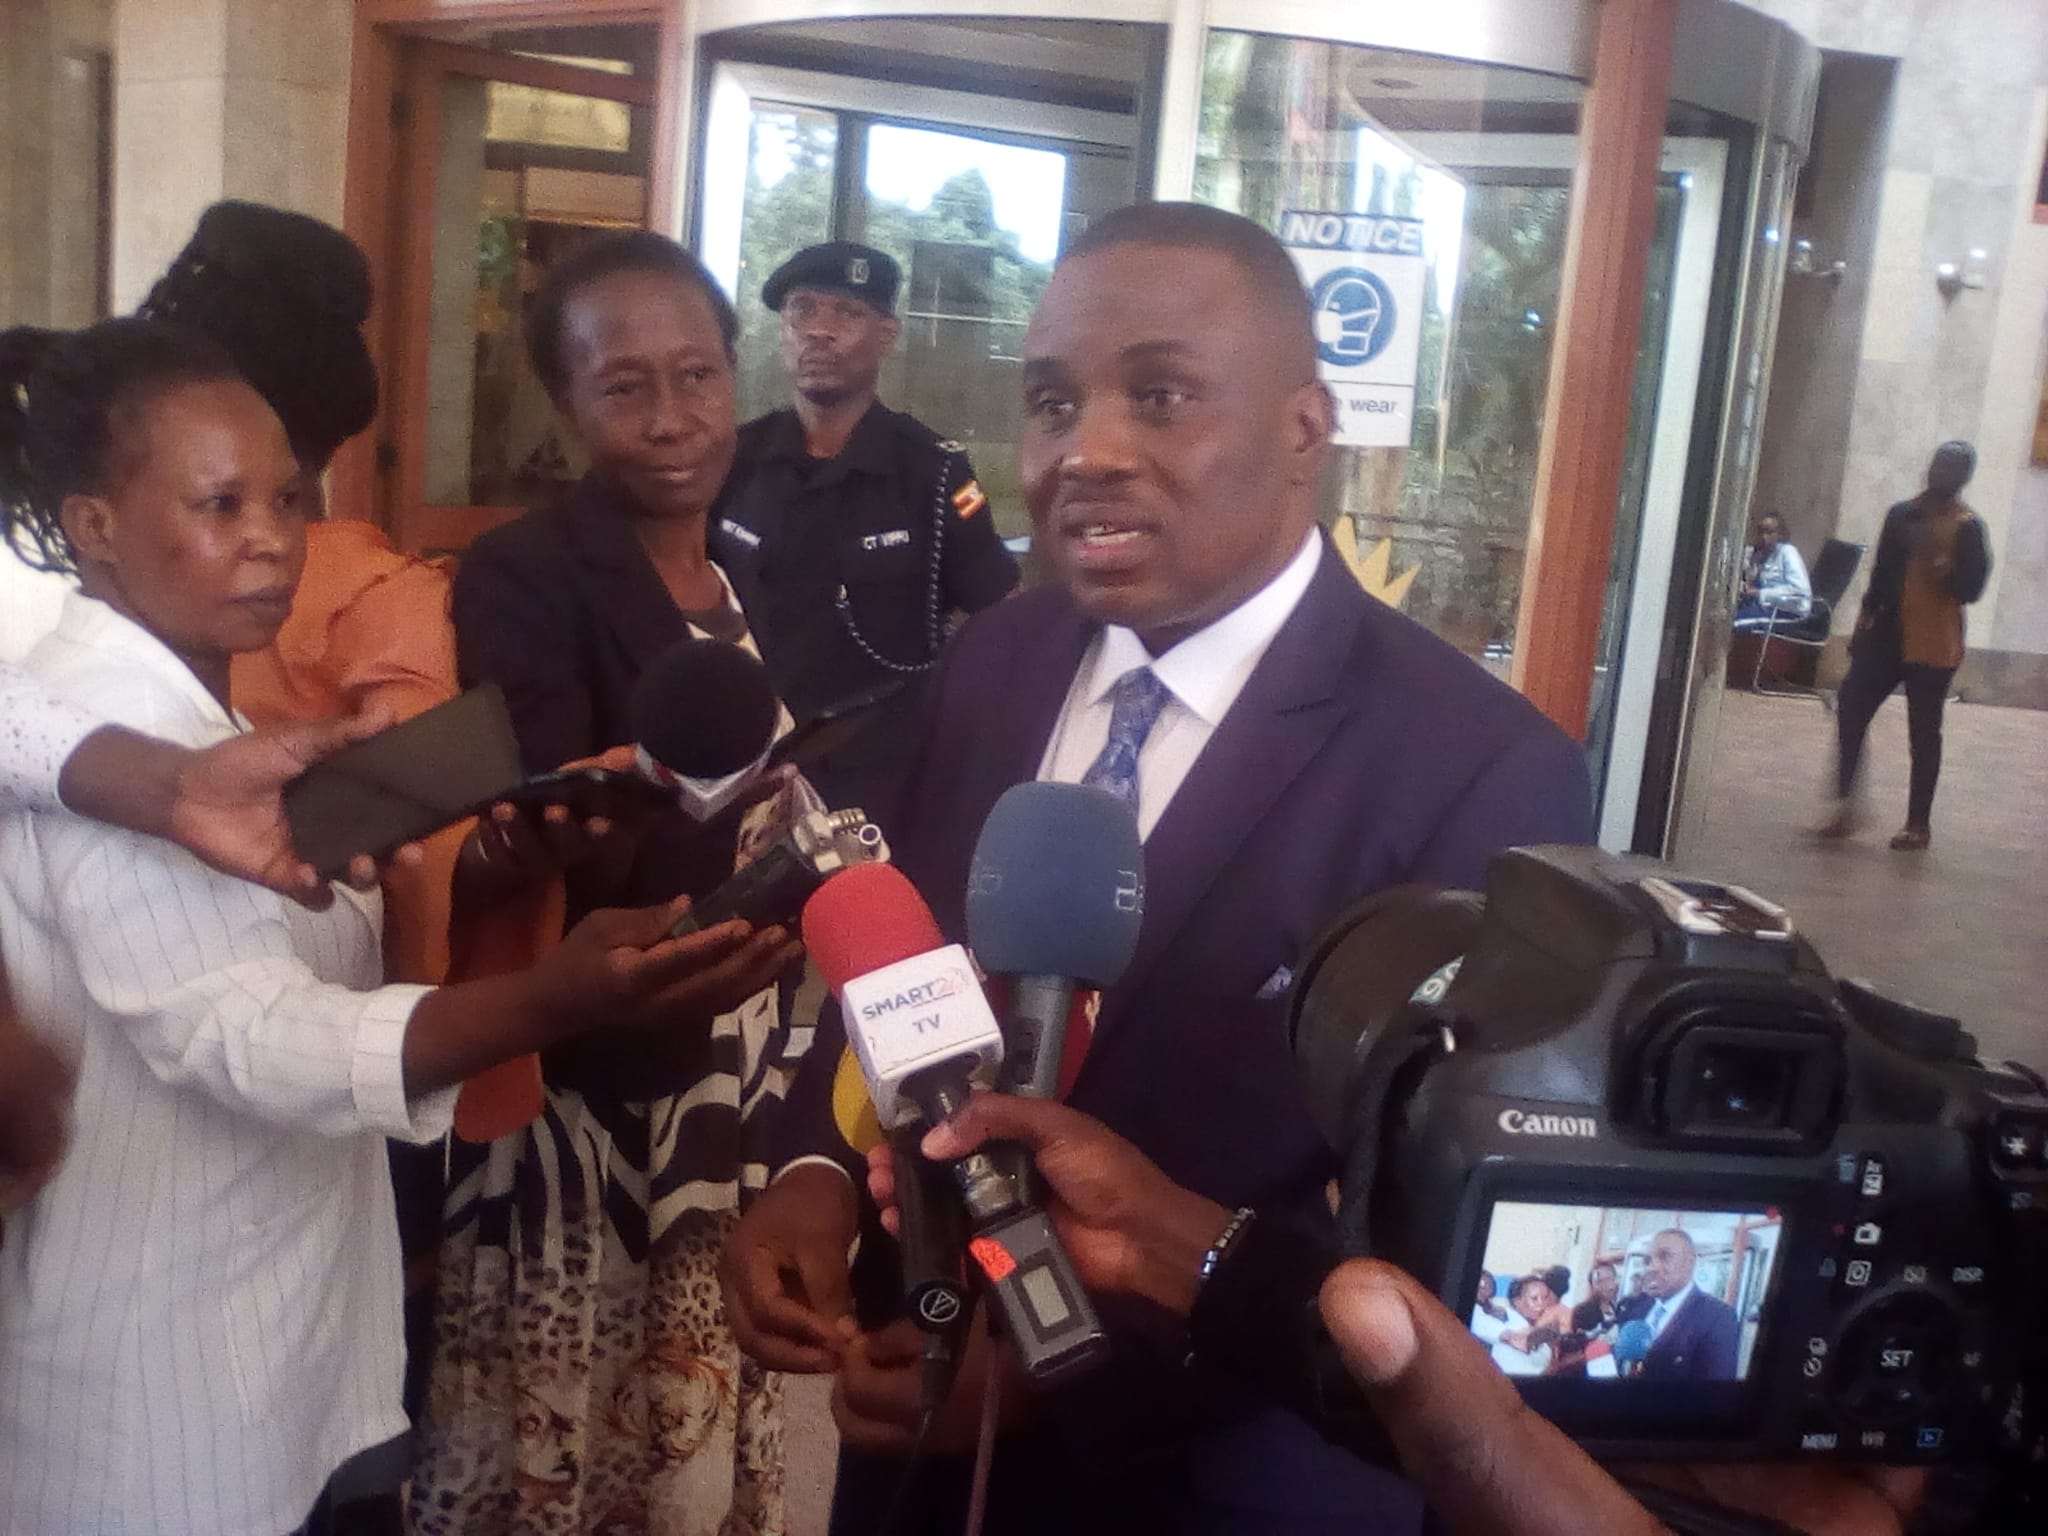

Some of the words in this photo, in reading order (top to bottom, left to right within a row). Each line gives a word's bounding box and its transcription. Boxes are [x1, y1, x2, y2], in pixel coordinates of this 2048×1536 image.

[1287, 213, 1420, 251] NOTICE
[1350, 399, 1397, 413] wear
[912, 1013, 941, 1034] TV
[1498, 1109, 1597, 1137] Canon
[1880, 1350, 1913, 1366] SET
